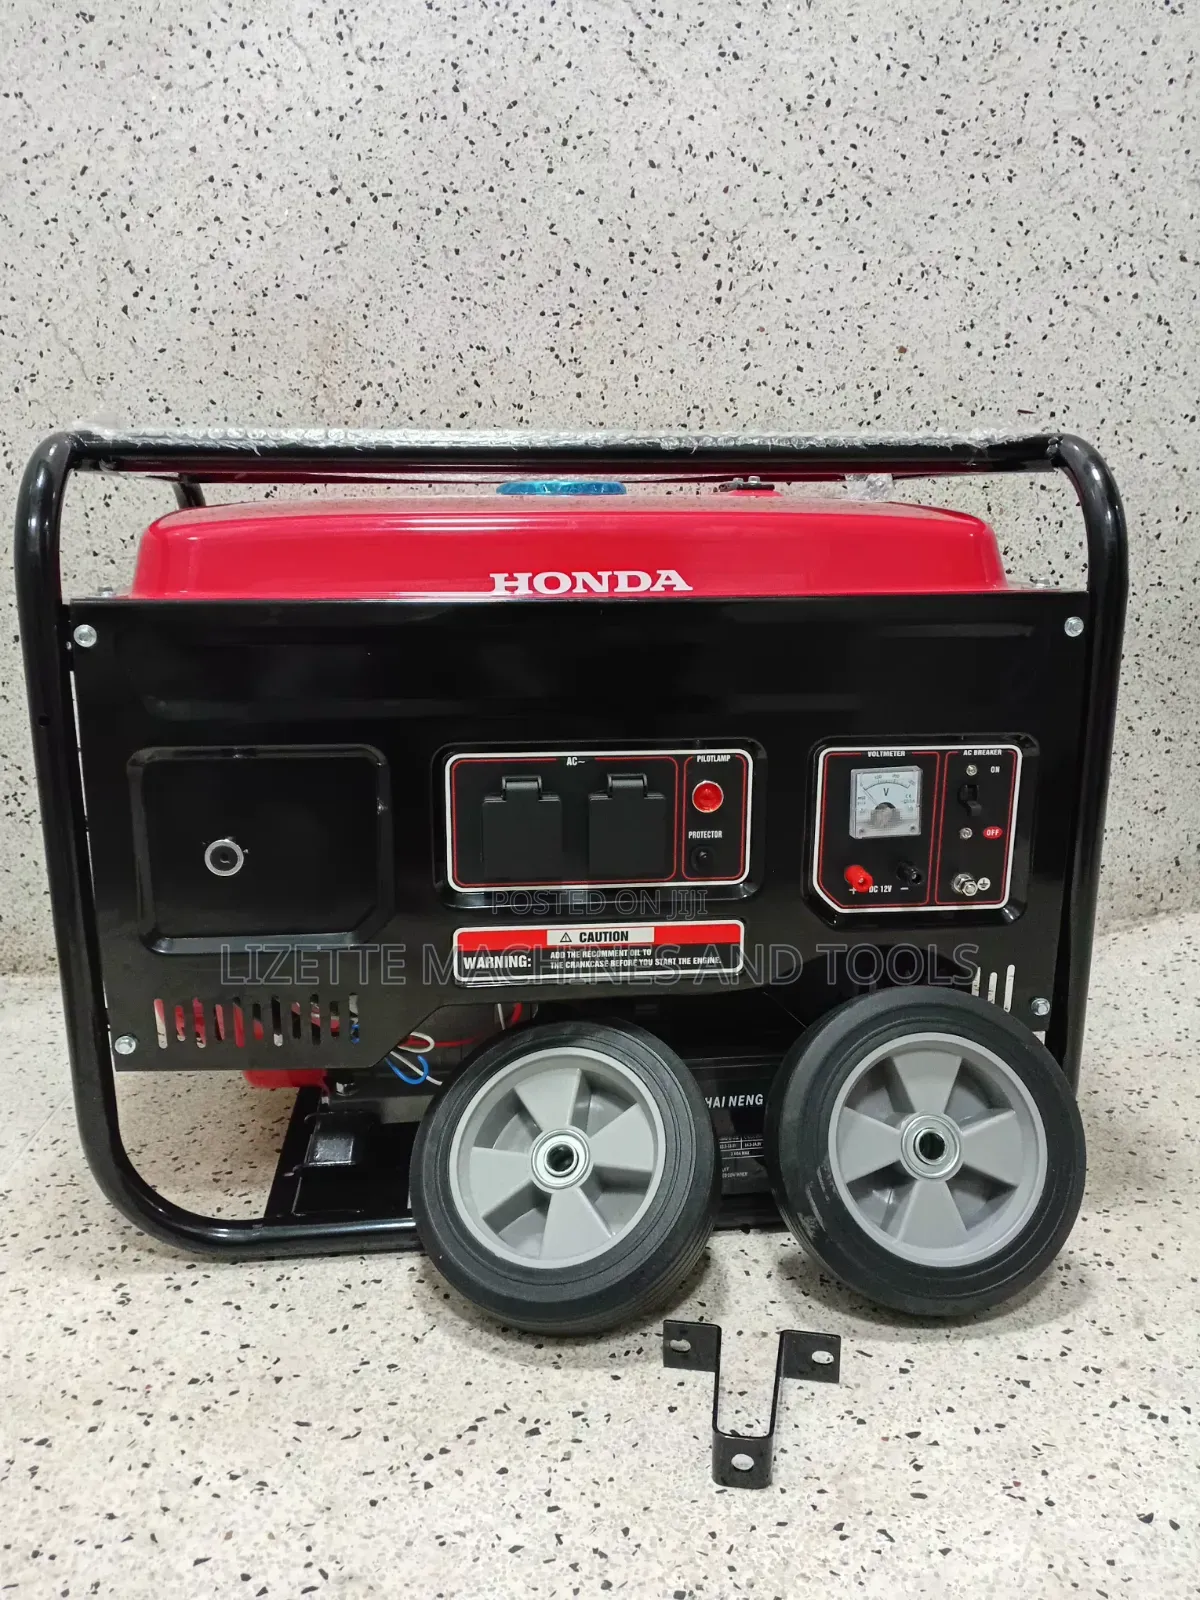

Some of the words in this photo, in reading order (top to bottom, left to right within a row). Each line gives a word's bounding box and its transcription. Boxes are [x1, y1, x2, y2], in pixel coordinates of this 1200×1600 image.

[490, 570, 693, 594] HONDA
[867, 750, 906, 758] VOLTMETER
[973, 748, 1003, 756] BREAKER
[696, 754, 731, 763] PILOTLAMP
[990, 765, 1001, 774] ON
[883, 787, 890, 797] V
[688, 830, 723, 839] PROTECTOR
[986, 828, 1000, 836] OFF
[868, 885, 878, 893] DC
[880, 884, 893, 893] 12V
[579, 930, 629, 943] CAUTION
[550, 951, 564, 959] ADD
[566, 950, 581, 959] THE
[582, 949, 628, 958] RECOMMENT
[629, 948, 641, 957] OIL
[642, 948, 652, 956] TO
[463, 955, 532, 970] WARNING:
[550, 961, 564, 969] THE
[565, 960, 609, 969] CRANKCASE
[610, 959, 637, 967] BEFORE
[639, 958, 653, 966] YOU
[654, 957, 676, 966] START
[678, 957, 692, 965] THE
[692, 956, 722, 965] ENGINE.
[728, 1093, 764, 1108] NENG
